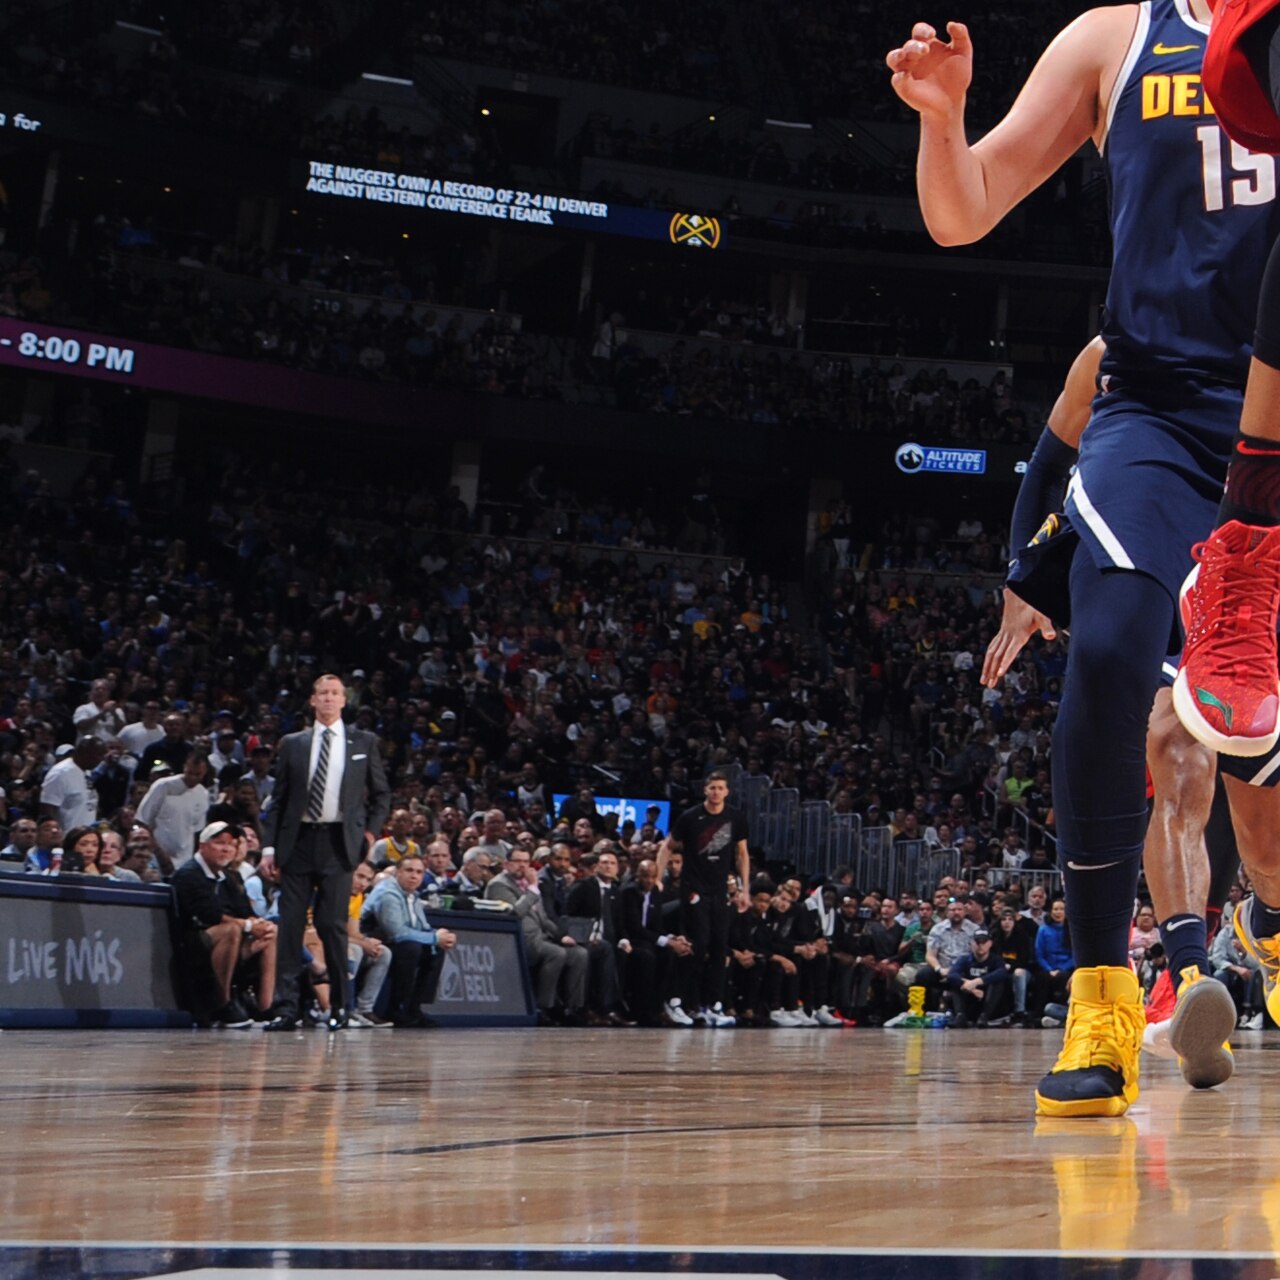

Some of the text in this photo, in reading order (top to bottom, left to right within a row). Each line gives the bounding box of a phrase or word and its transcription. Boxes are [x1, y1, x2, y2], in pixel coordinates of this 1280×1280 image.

[12, 112, 41, 132] for
[1197, 125, 1276, 212] 15
[306, 178, 554, 226] AGAINST WESTERN CONFERENCE TEAMS.
[309, 161, 607, 218] THE NUGGETS OWN A RECORD OF 22-4 IN DENVER
[18, 331, 135, 373] 8:00 PM
[924, 461, 980, 471] TICKETS
[926, 450, 981, 463] ALTITUDE
[65, 930, 122, 985] MÁS
[456, 943, 494, 971] TACO
[463, 975, 499, 1003] BELL
